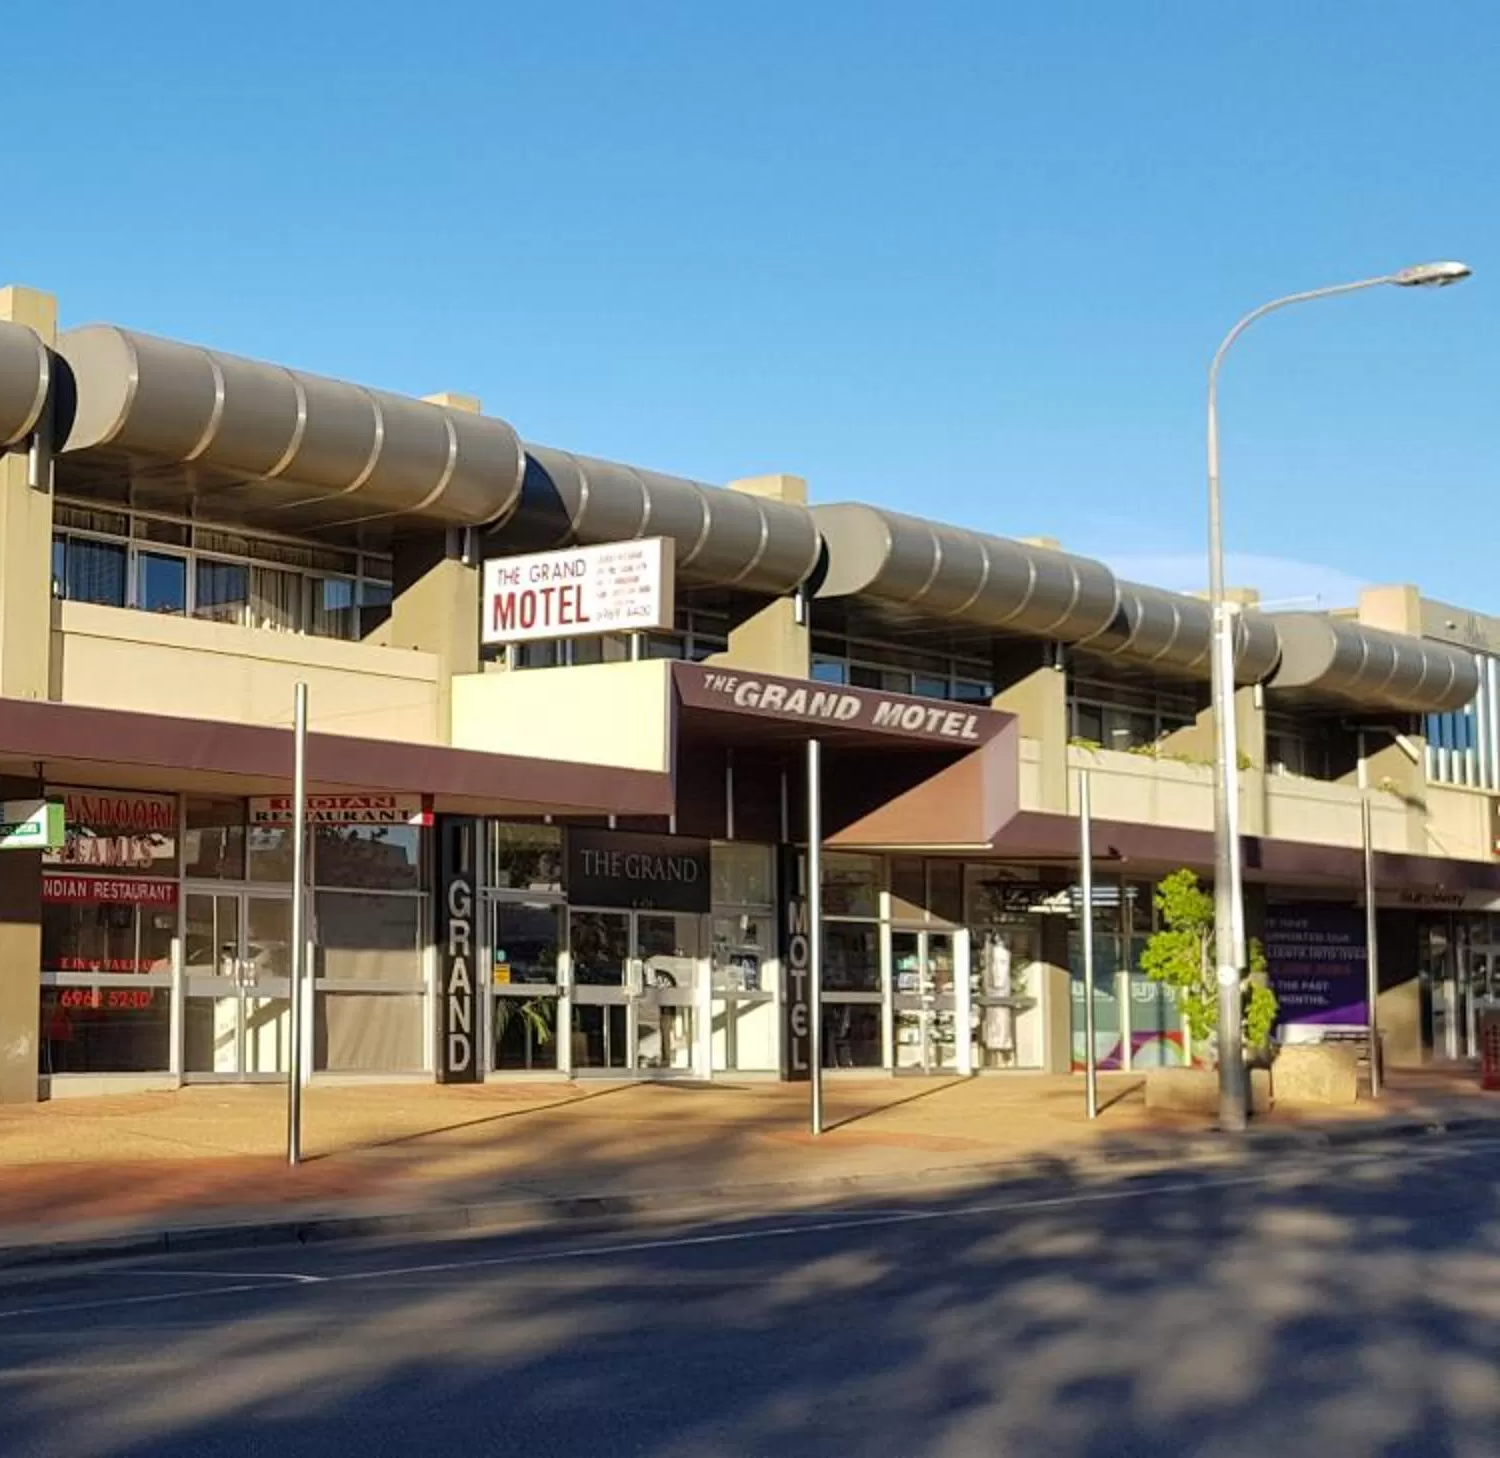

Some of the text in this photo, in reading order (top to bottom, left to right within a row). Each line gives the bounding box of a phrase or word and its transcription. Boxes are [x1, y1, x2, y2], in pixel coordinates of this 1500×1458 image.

[498, 567, 520, 585] THE
[529, 559, 586, 583] GRAND
[493, 584, 590, 632] MOTEL
[703, 673, 979, 739] THE GRAND MOTEL
[67, 796, 173, 831] ANDOORI
[270, 796, 396, 809] IDIAN
[580, 850, 698, 882] THE GRAND
[43, 880, 173, 901] NDIAN RESTAURANT
[448, 879, 471, 1072] GRAND
[788, 900, 808, 1071] MOTEL
